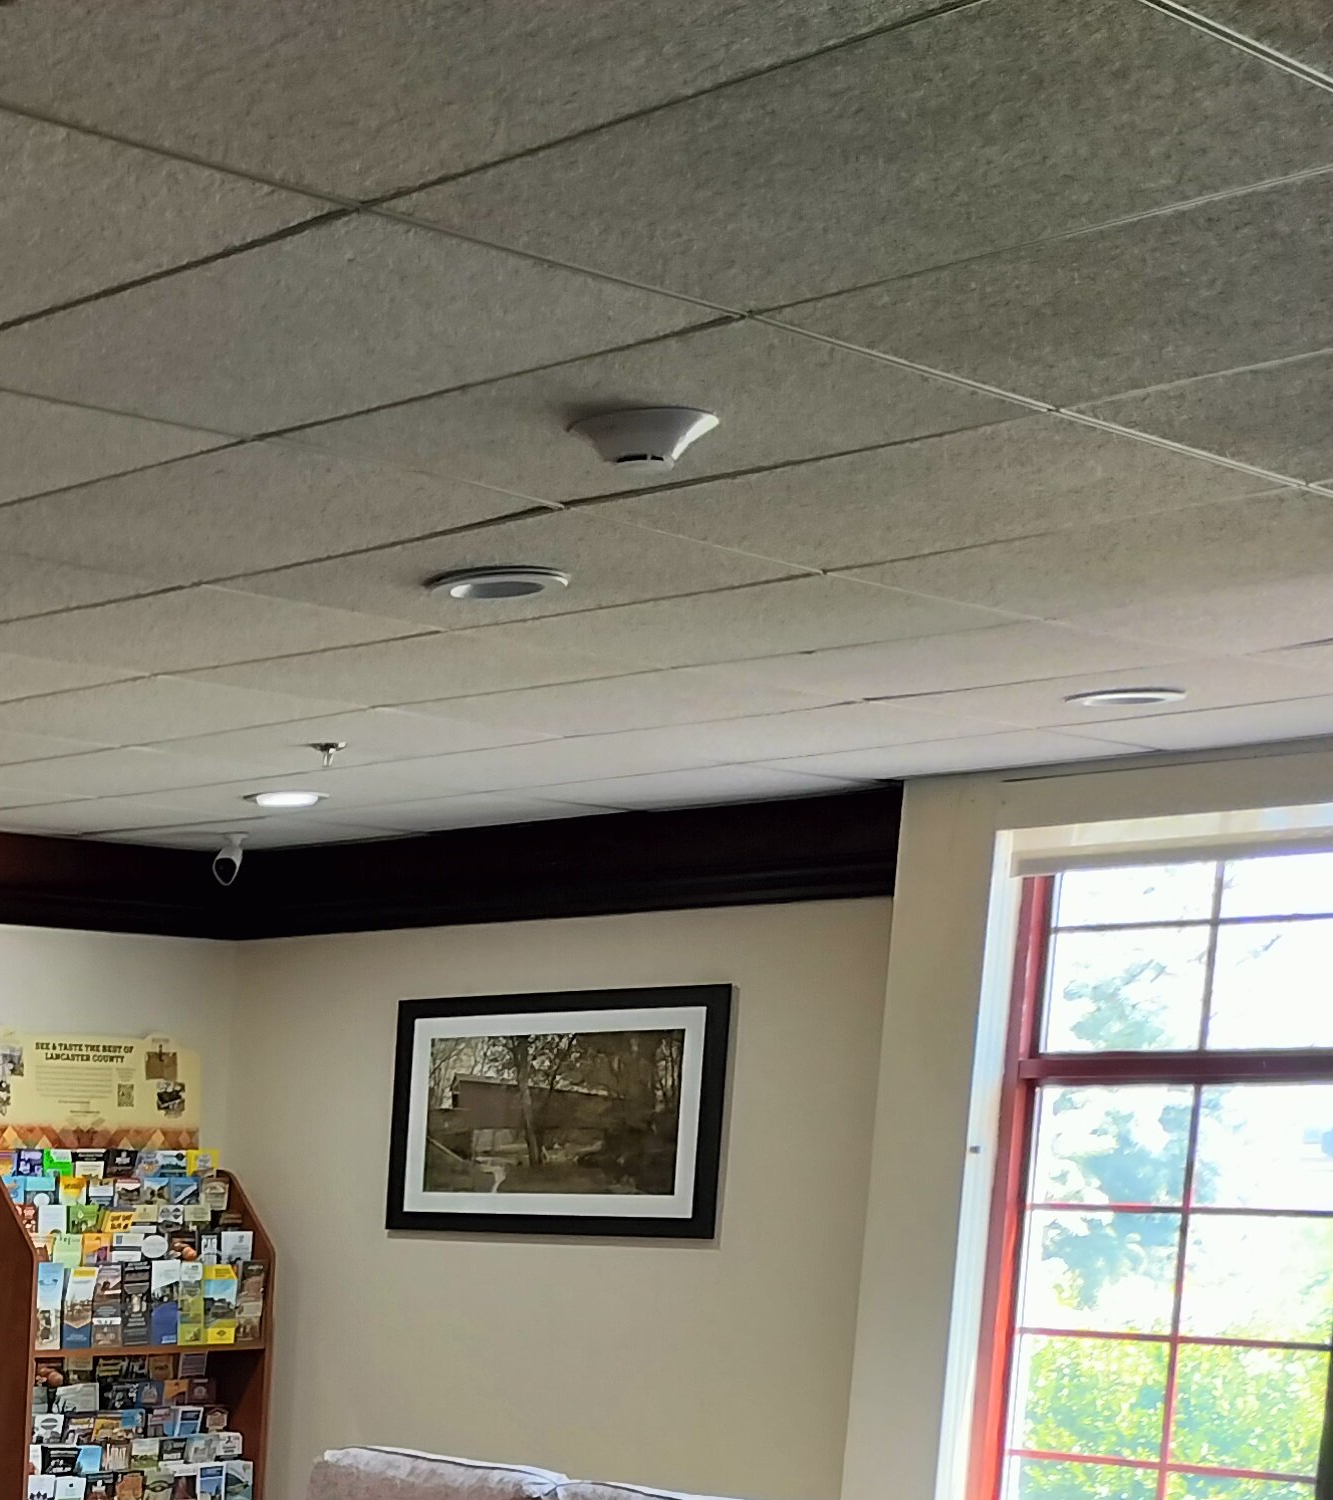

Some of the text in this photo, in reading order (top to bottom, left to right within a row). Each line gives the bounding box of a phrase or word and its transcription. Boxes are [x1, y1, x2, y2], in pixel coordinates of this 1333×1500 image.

[35, 1042, 50, 1050] SEE
[58, 1043, 83, 1052] TASTE
[85, 1044, 100, 1052] THE
[102, 1045, 122, 1053] BEST
[45, 1052, 125, 1063] LANCASTER COUNTY
